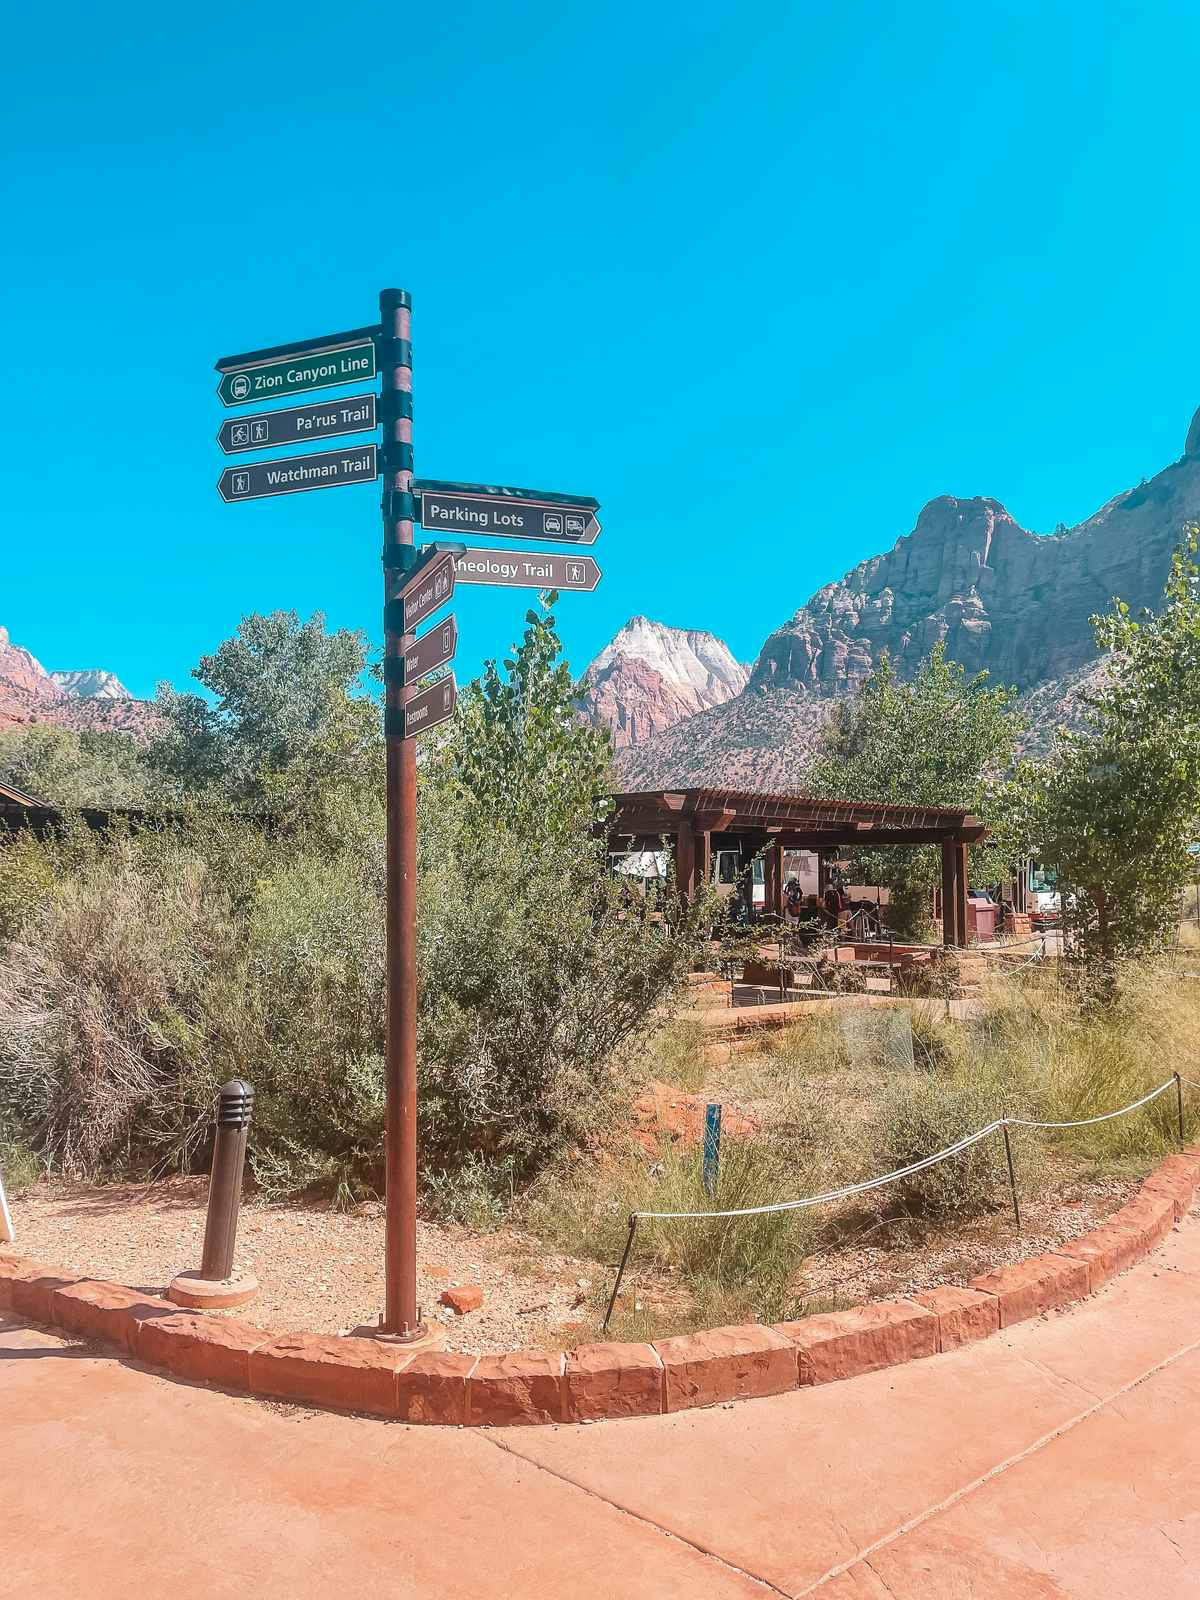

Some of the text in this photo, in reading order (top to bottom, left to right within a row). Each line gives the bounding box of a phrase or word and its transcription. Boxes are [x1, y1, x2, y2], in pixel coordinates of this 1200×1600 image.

[255, 357, 369, 390] Zion Canyon Line
[340, 405, 369, 423] Trail
[267, 455, 370, 485] Watchman Trail
[430, 504, 524, 527] Parking Lots
[523, 562, 553, 578] Trail
[418, 587, 433, 609] Center
[406, 704, 429, 726] Restrooms
